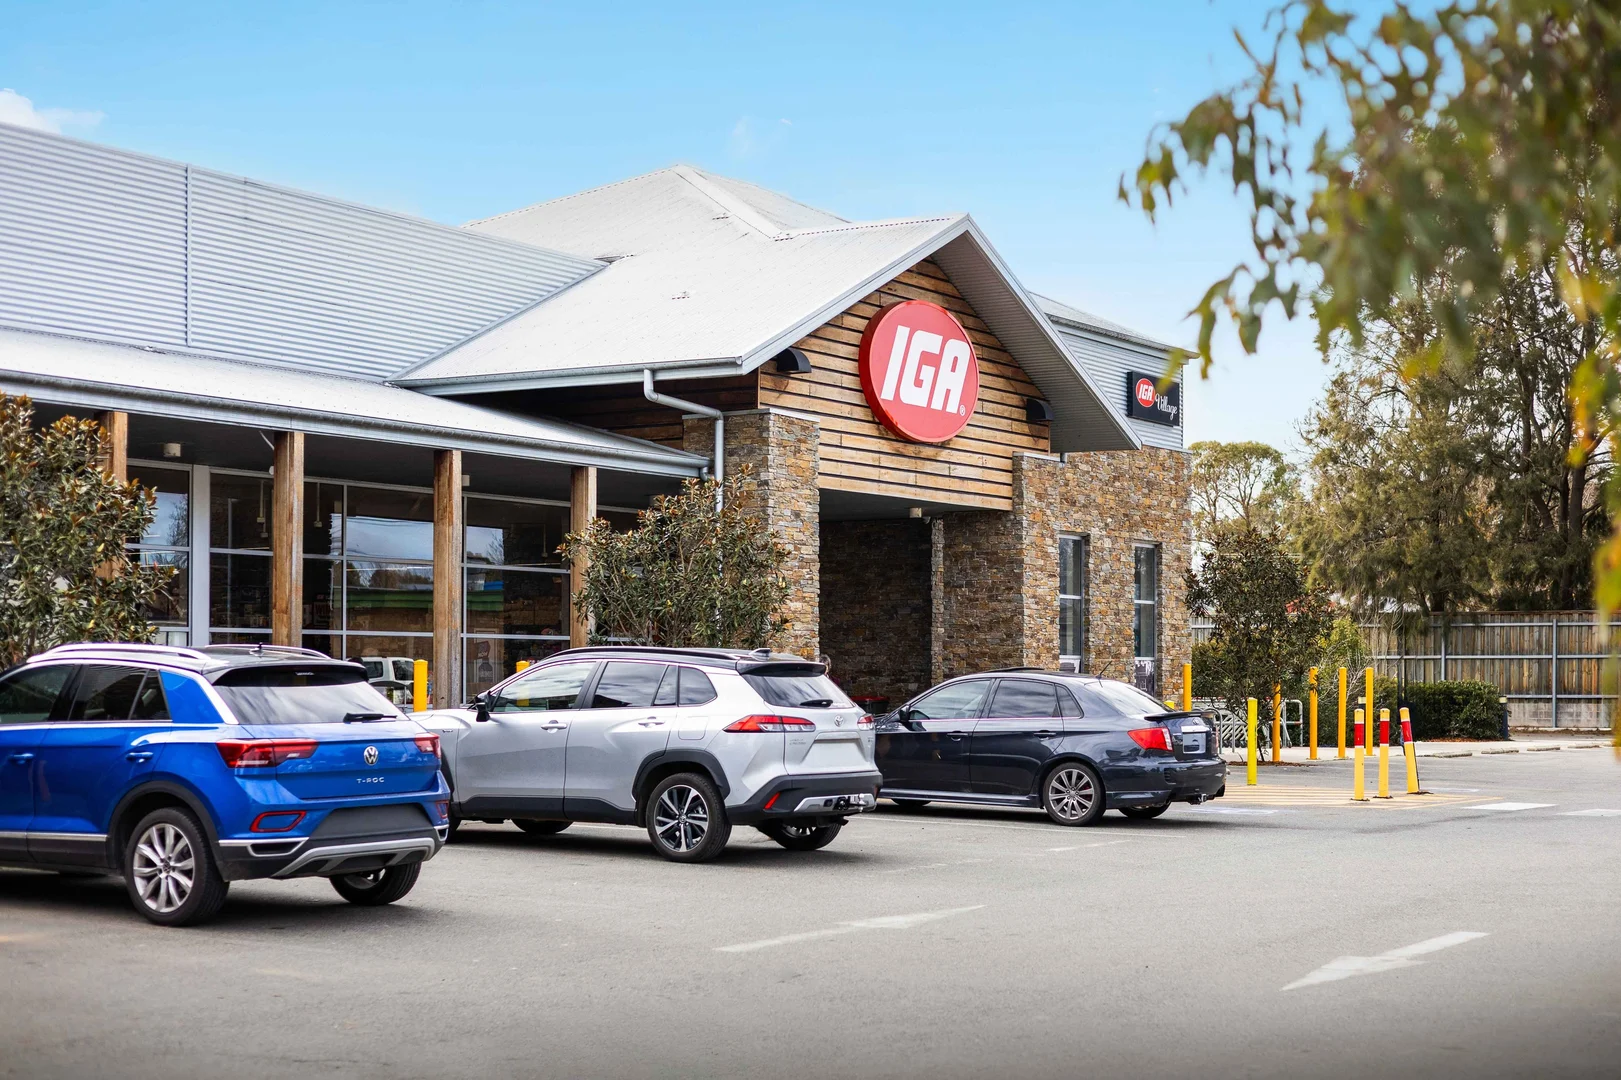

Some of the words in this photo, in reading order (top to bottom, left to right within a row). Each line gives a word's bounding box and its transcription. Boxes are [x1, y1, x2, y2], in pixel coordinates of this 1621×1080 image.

[880, 324, 971, 414] IGA
[1138, 383, 1154, 401] IGA
[1155, 393, 1178, 421] Village
[356, 776, 384, 784] T-ROC
